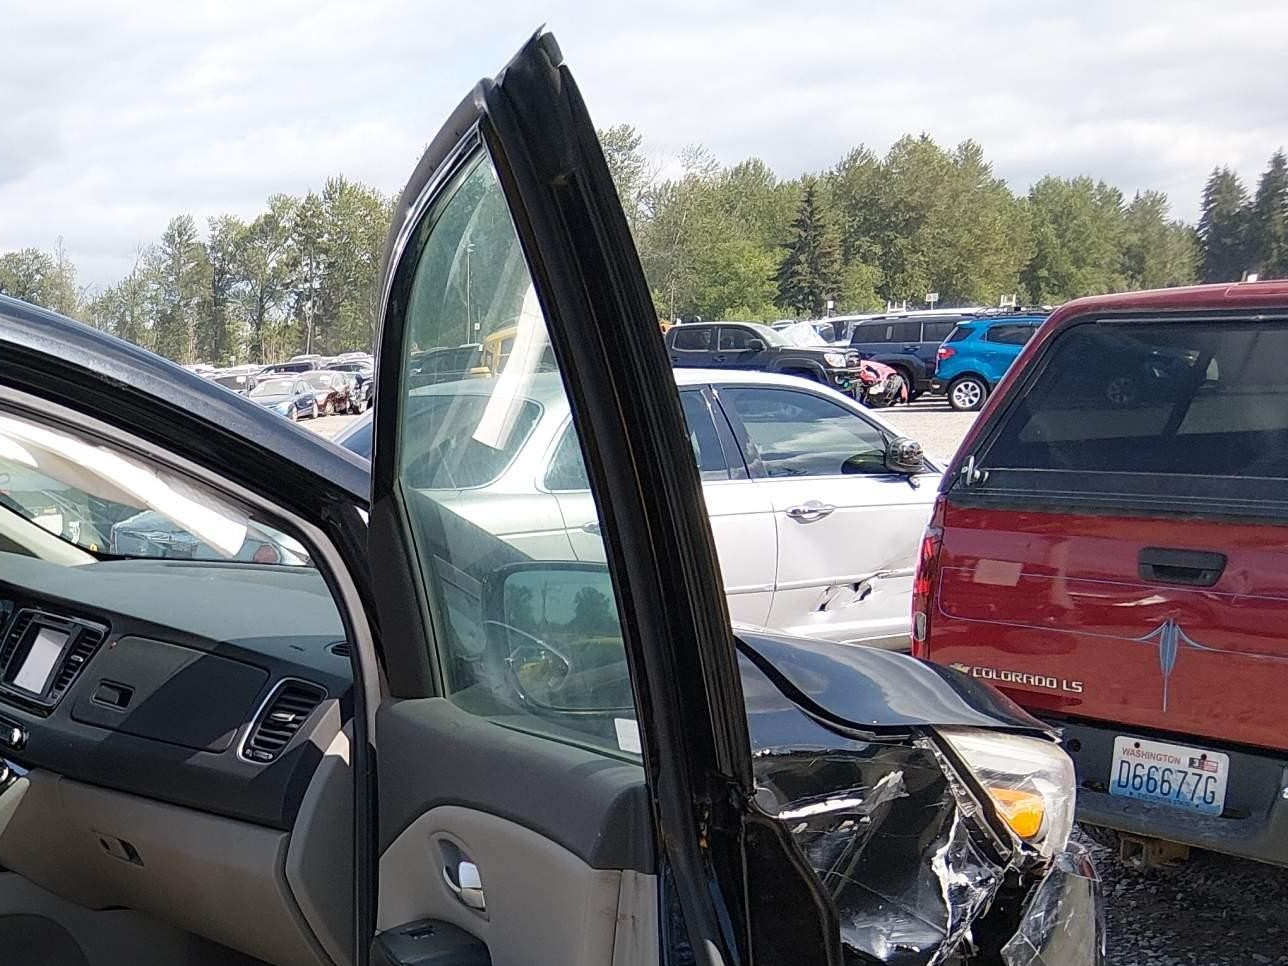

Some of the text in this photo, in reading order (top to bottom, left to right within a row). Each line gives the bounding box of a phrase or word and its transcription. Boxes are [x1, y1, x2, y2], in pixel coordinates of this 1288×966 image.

[972, 666, 1083, 693] COLORADO LS
[1122, 747, 1181, 765] WASHINGTON
[1117, 760, 1217, 805] D66677G
